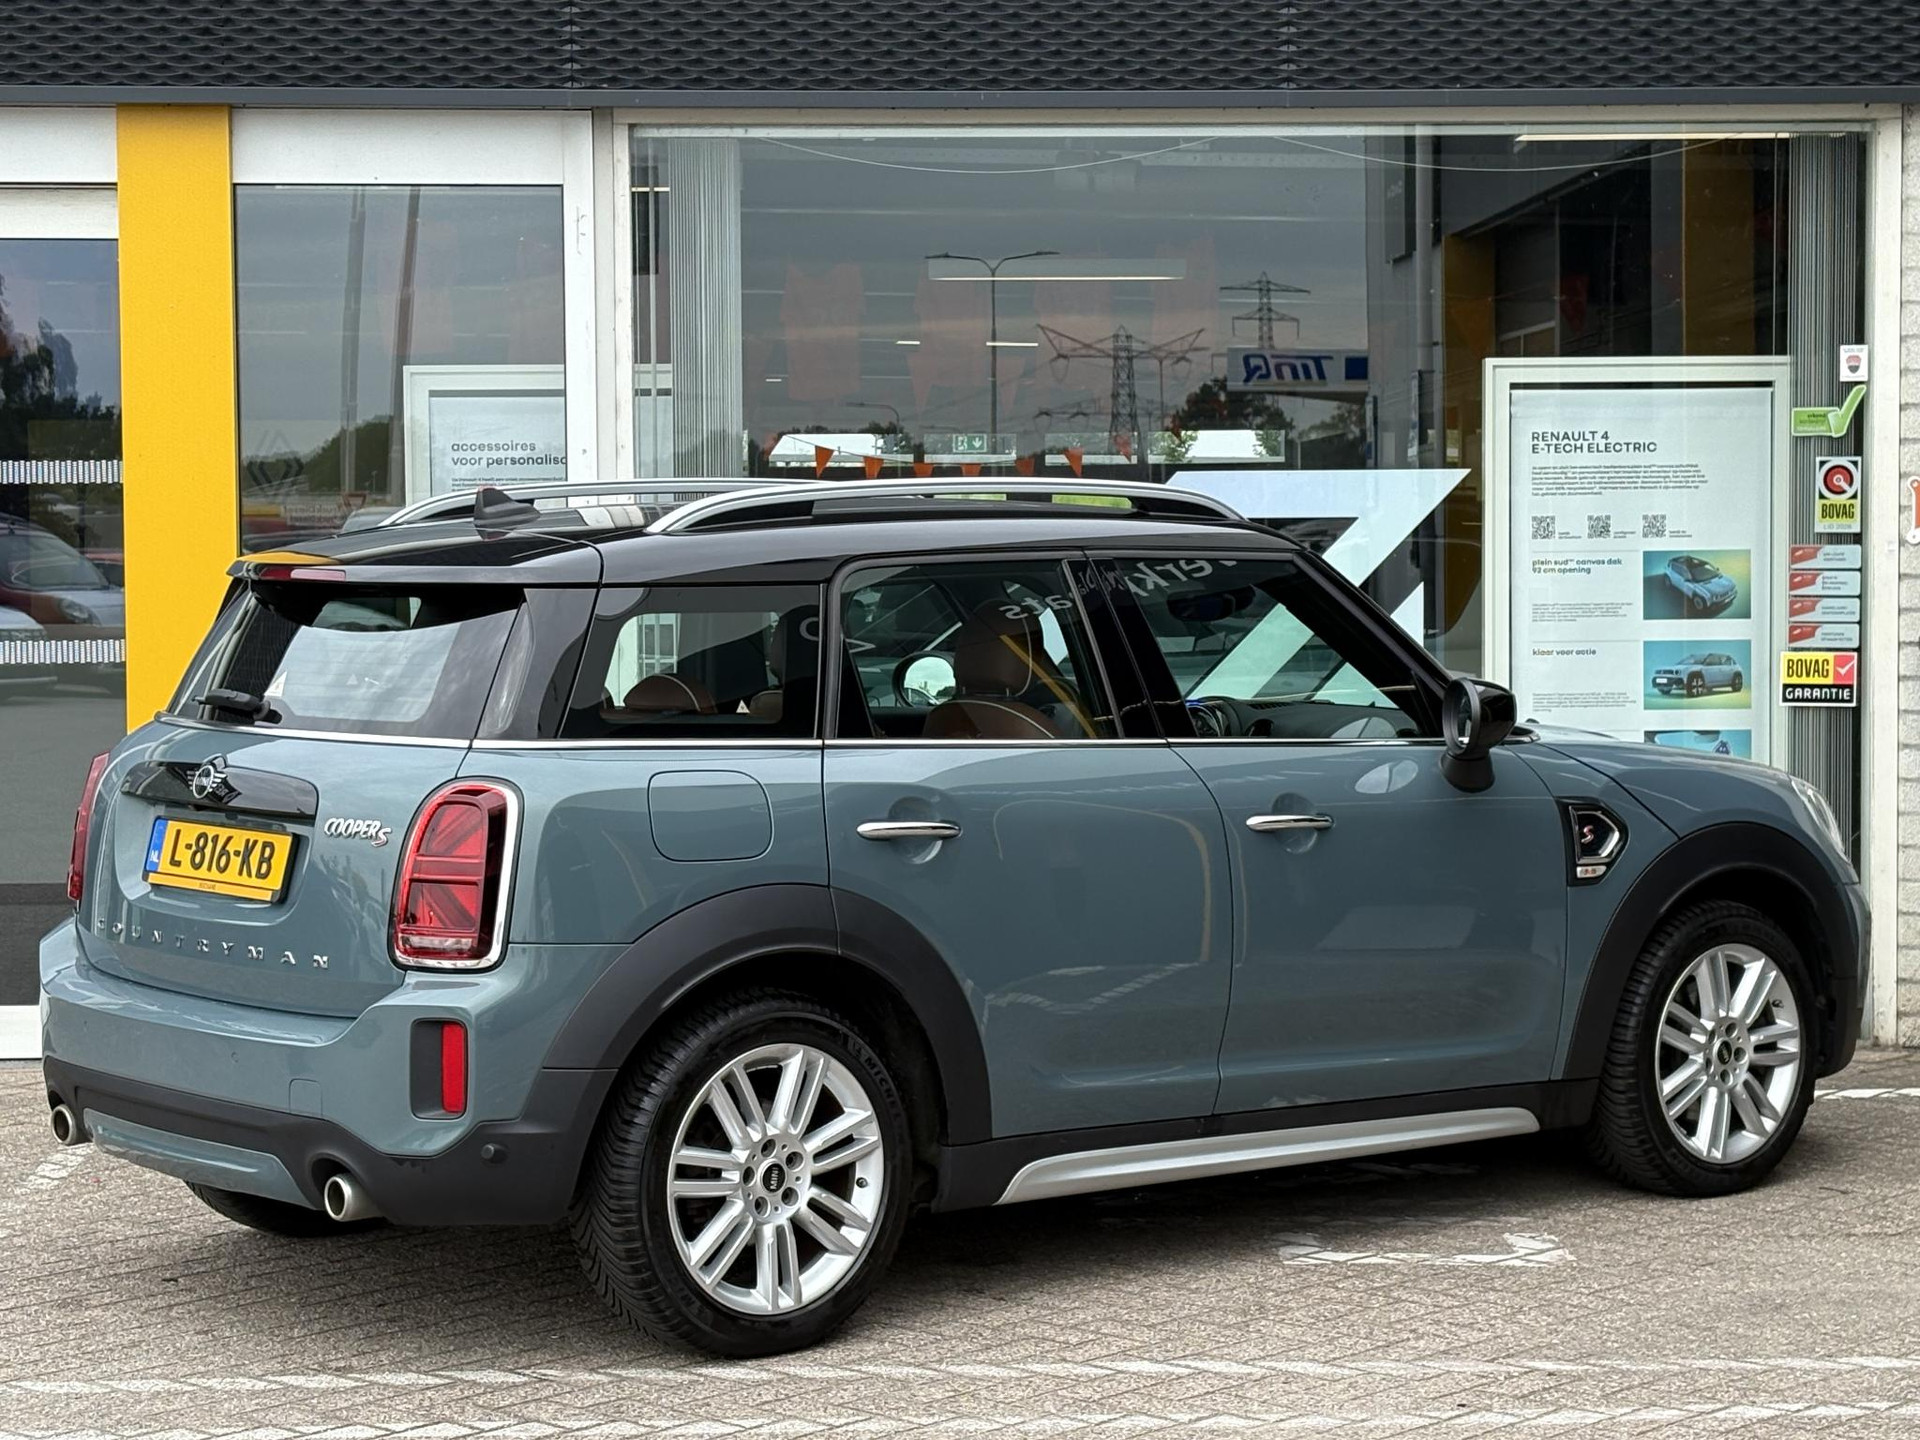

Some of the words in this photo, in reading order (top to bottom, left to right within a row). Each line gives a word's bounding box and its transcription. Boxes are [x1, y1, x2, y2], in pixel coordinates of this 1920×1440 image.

[1531, 430, 1598, 442] RENAULT
[1600, 430, 1610, 441] 4
[451, 440, 537, 452] accessoires
[1531, 442, 1584, 454] E-TECH
[1587, 441, 1658, 453] ELECTRIC
[451, 456, 484, 466] voor
[1821, 503, 1855, 520] BOVAG
[1532, 558, 1553, 567] plein
[1575, 558, 1606, 566] canvas
[1606, 557, 1622, 565] dak
[1532, 566, 1542, 574] 92
[1557, 566, 1592, 575] opening
[1575, 648, 1597, 656] actie
[1786, 658, 1830, 679] BOVAG
[1785, 687, 1851, 700] GARANTIE
[168, 828, 276, 880] L-816-KB
[96, 918, 330, 969] COUNTRYMAN
[770, 1166, 779, 1190] MINI
